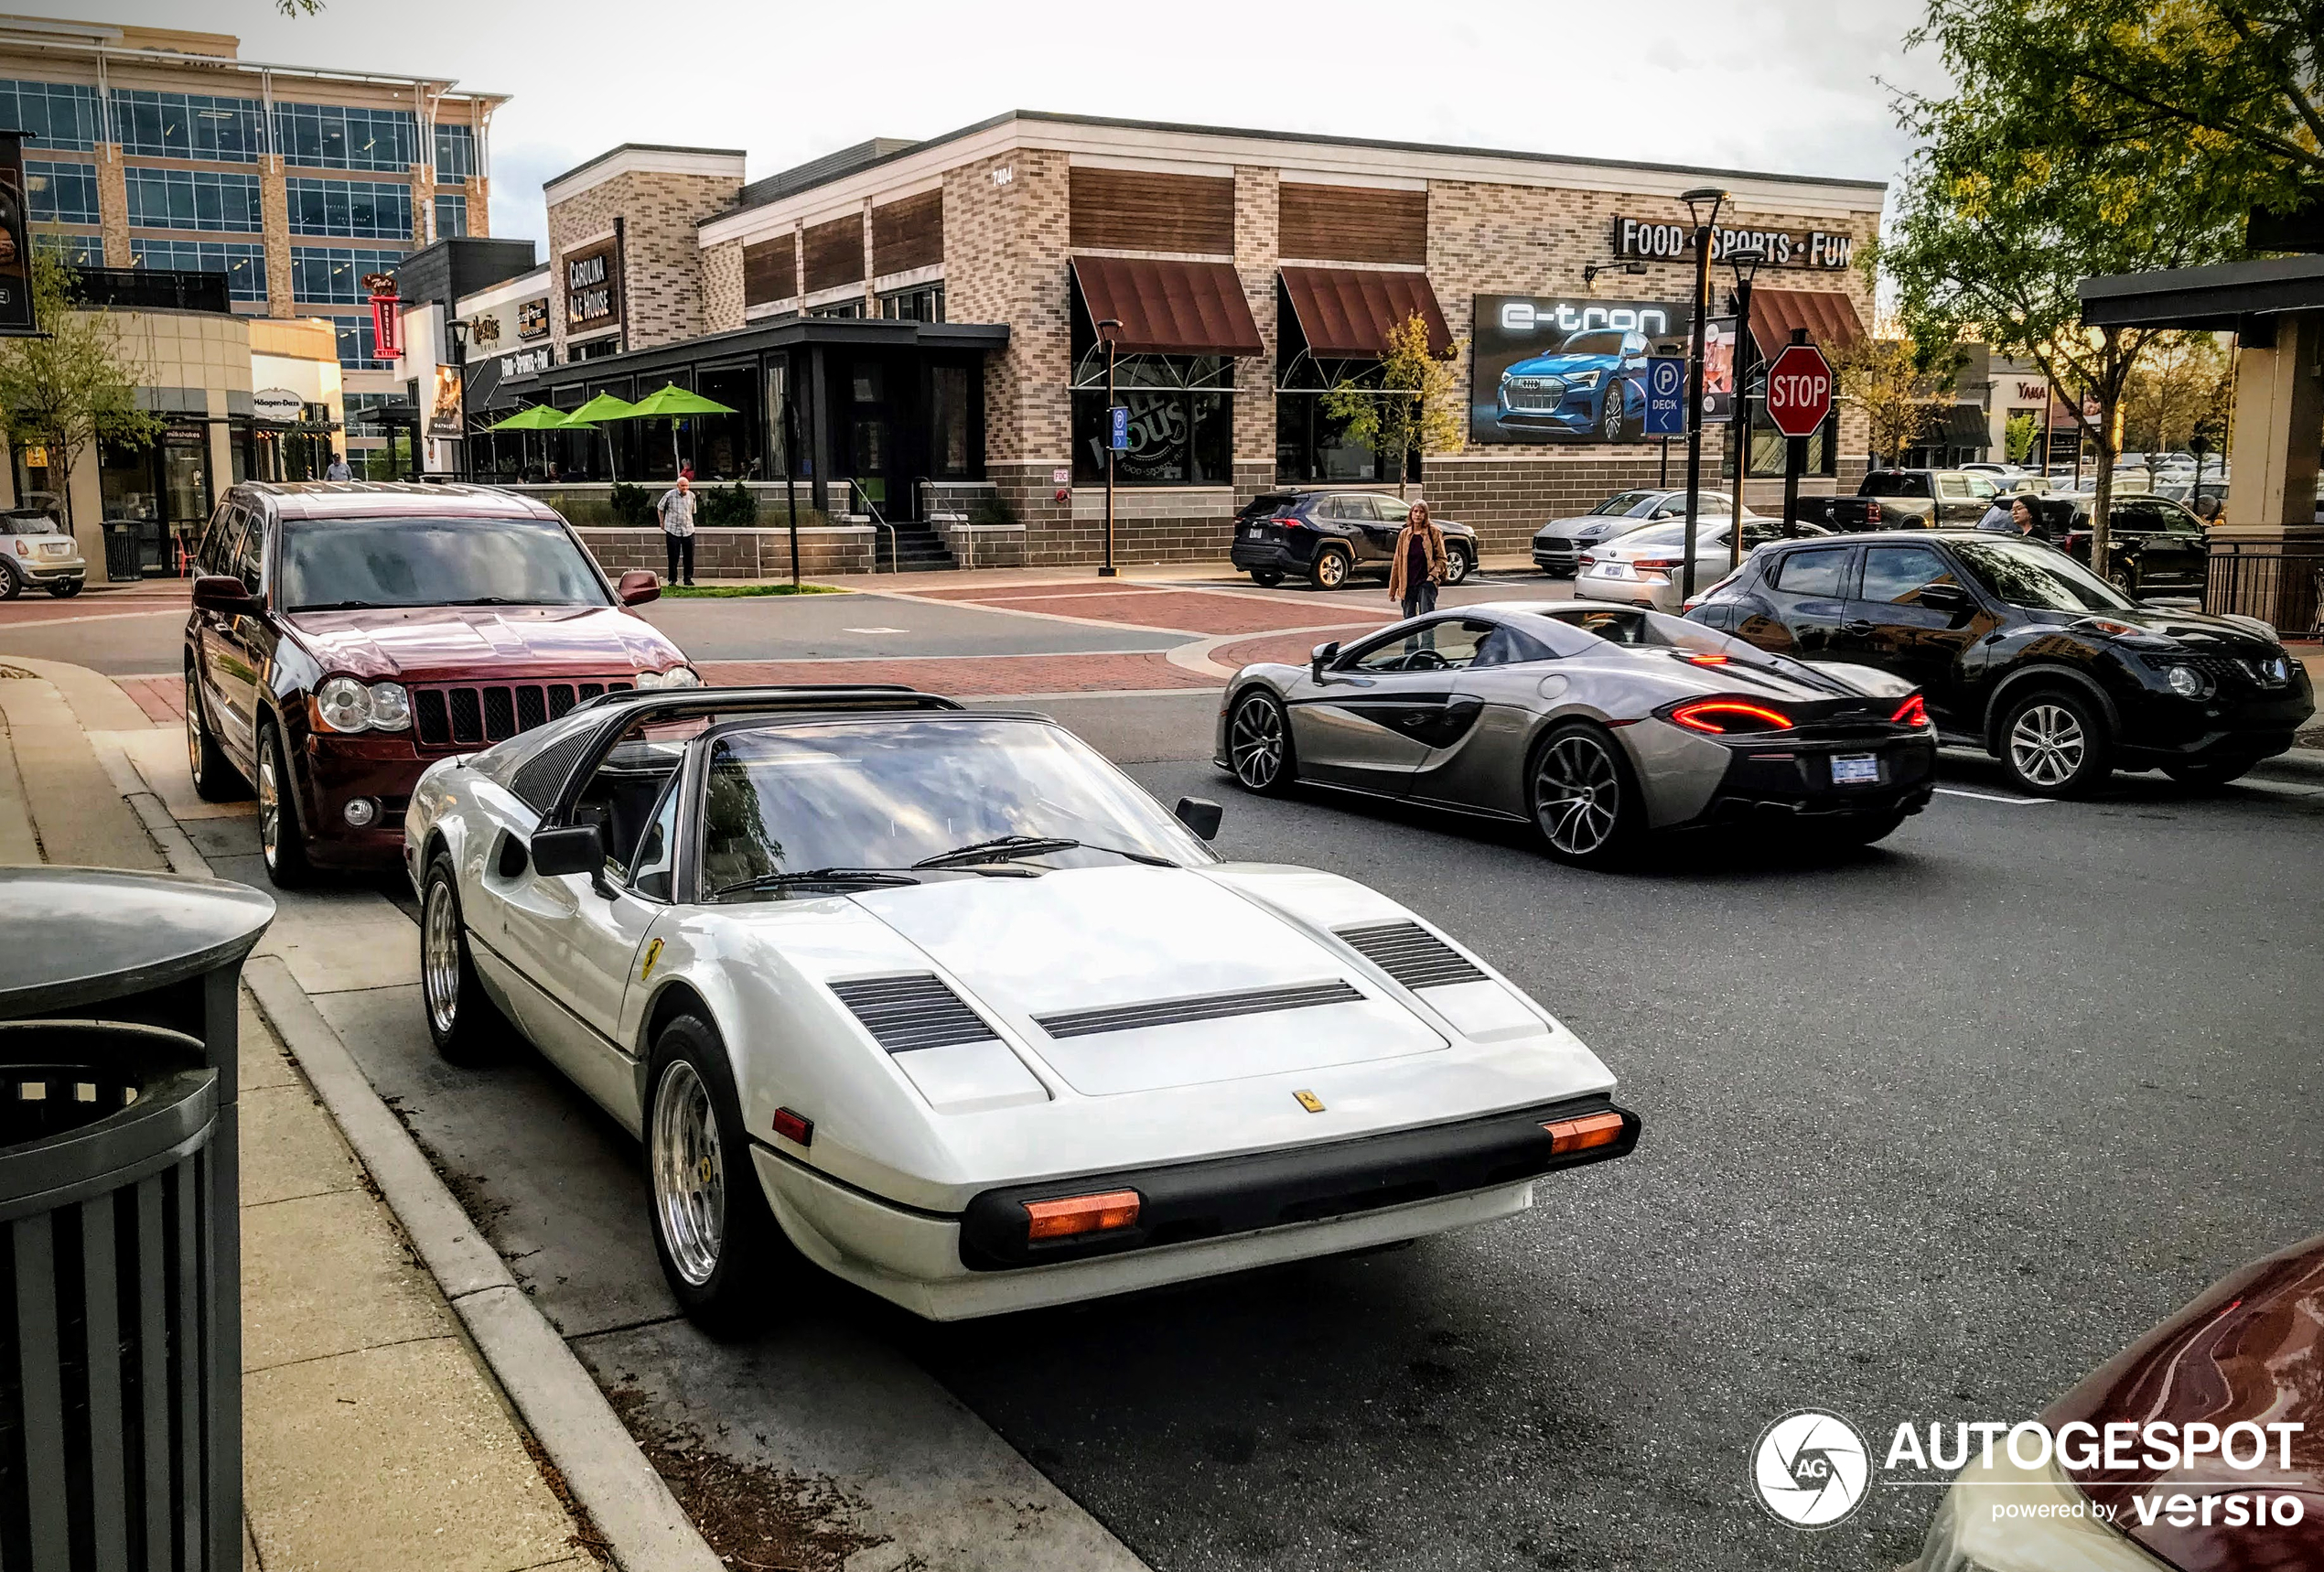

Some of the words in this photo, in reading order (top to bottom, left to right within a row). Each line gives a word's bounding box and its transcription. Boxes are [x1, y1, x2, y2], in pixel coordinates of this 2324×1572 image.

[993, 166, 1012, 187] 7404
[1623, 219, 1684, 256] FOOD
[1710, 225, 1790, 263] SPORTS
[1811, 232, 1852, 266] FUN
[570, 256, 605, 290] CAROLINA
[570, 296, 583, 324] ALE
[584, 290, 608, 319] HOUSE
[1501, 303, 1666, 334] e-tron
[1661, 371, 1673, 390] P
[1772, 375, 1827, 407] STOP
[1652, 400, 1677, 410] DECK
[1121, 462, 1143, 475] FOOD
